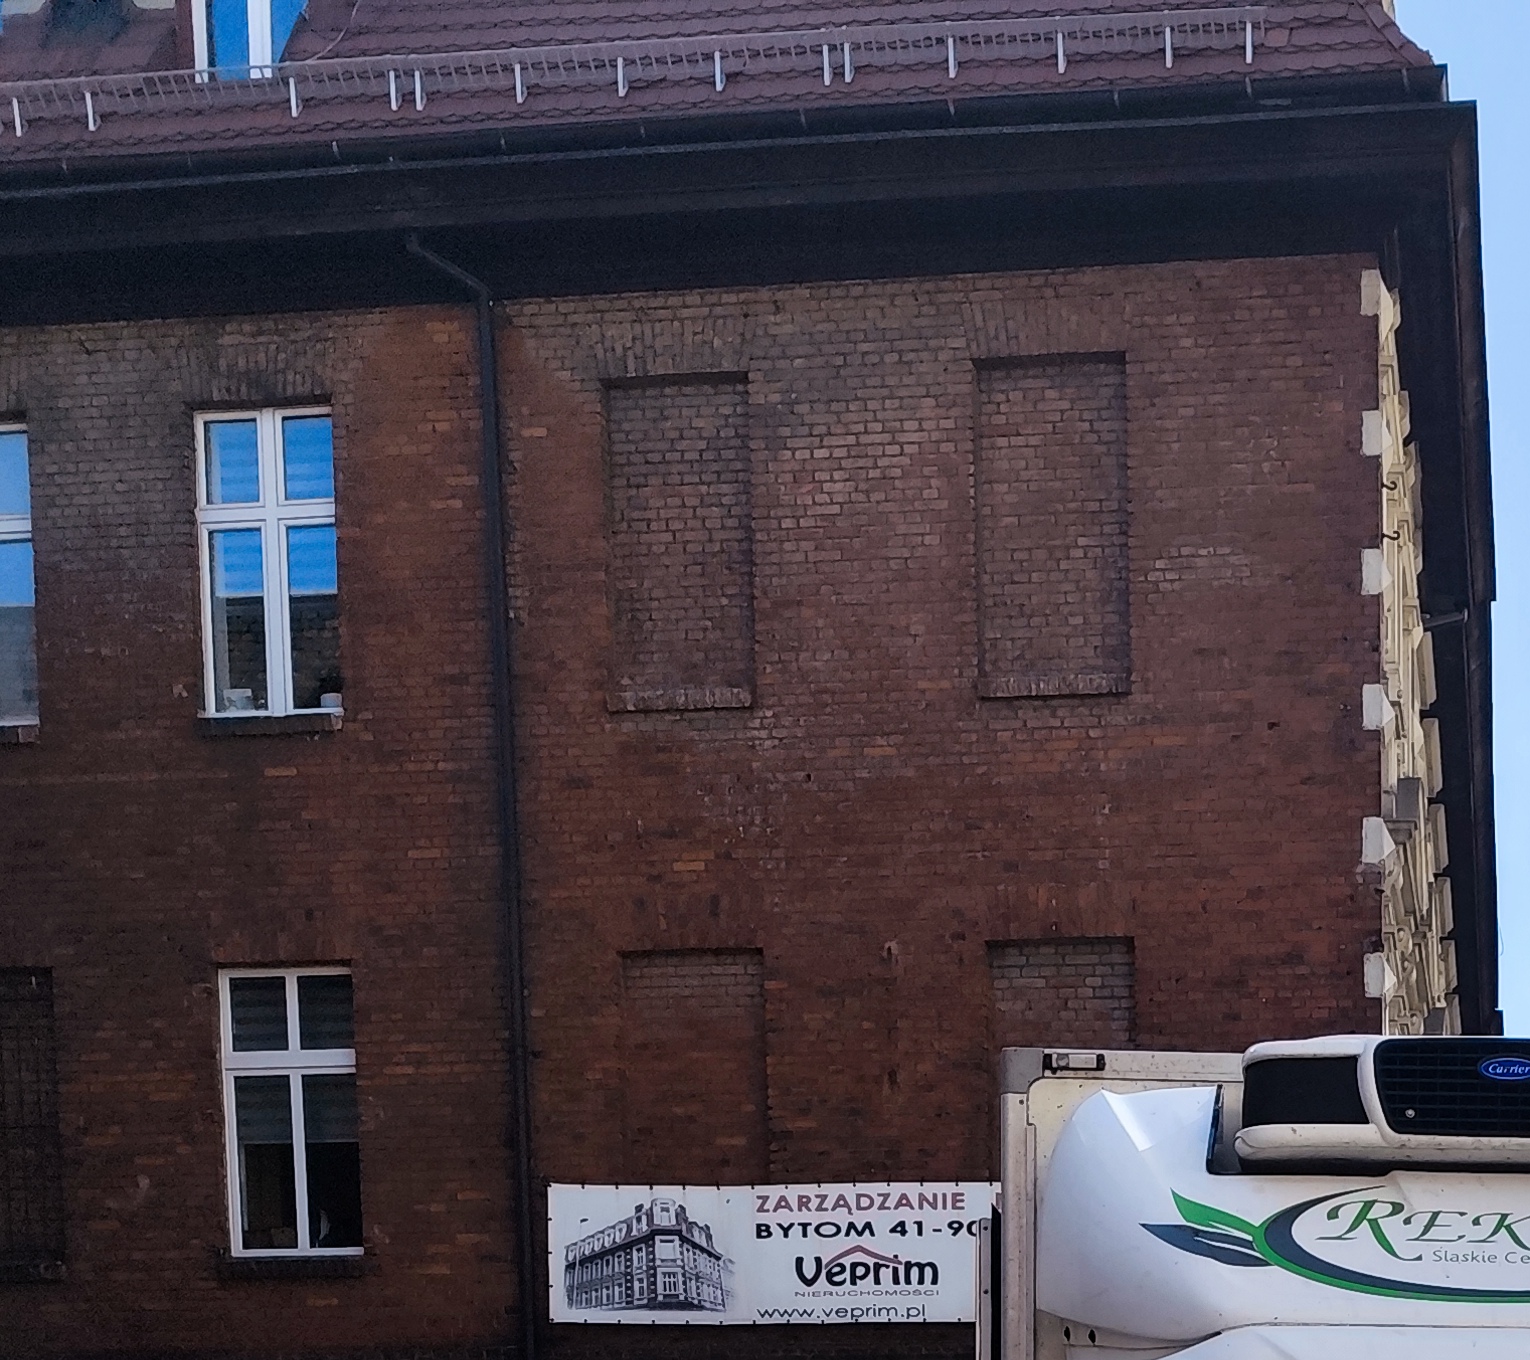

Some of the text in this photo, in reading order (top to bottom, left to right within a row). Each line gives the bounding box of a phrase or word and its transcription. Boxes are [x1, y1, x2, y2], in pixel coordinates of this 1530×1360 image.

[756, 1192, 966, 1216] ZARZĄDZANIE
[755, 1220, 876, 1240] BYTOM
[795, 1254, 939, 1288] Veprim
[795, 1288, 940, 1298] NIERUCHOMOŚCI
[756, 1303, 926, 1320] www.veprim.pl
